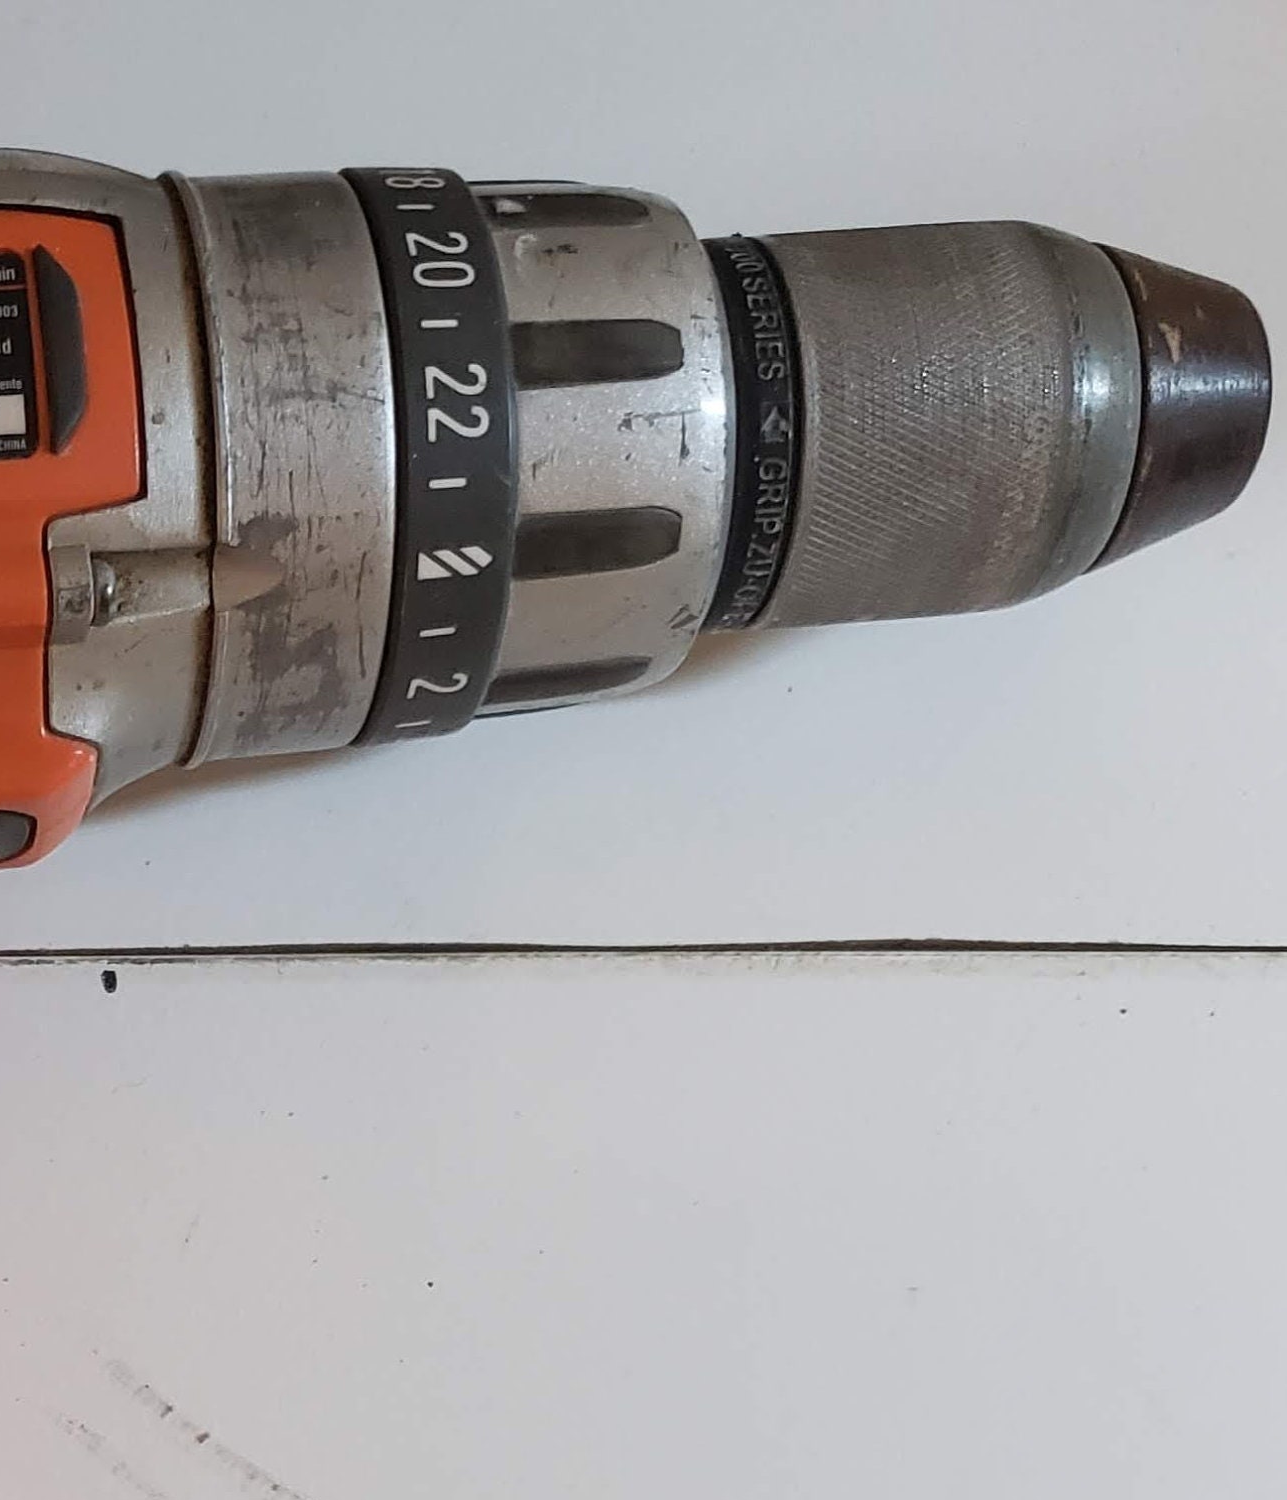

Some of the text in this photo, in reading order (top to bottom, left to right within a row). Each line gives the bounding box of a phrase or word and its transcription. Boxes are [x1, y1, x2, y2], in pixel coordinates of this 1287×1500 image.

[405, 231, 475, 287] 20
[424, 362, 490, 443] 22
[406, 672, 469, 700] 2
